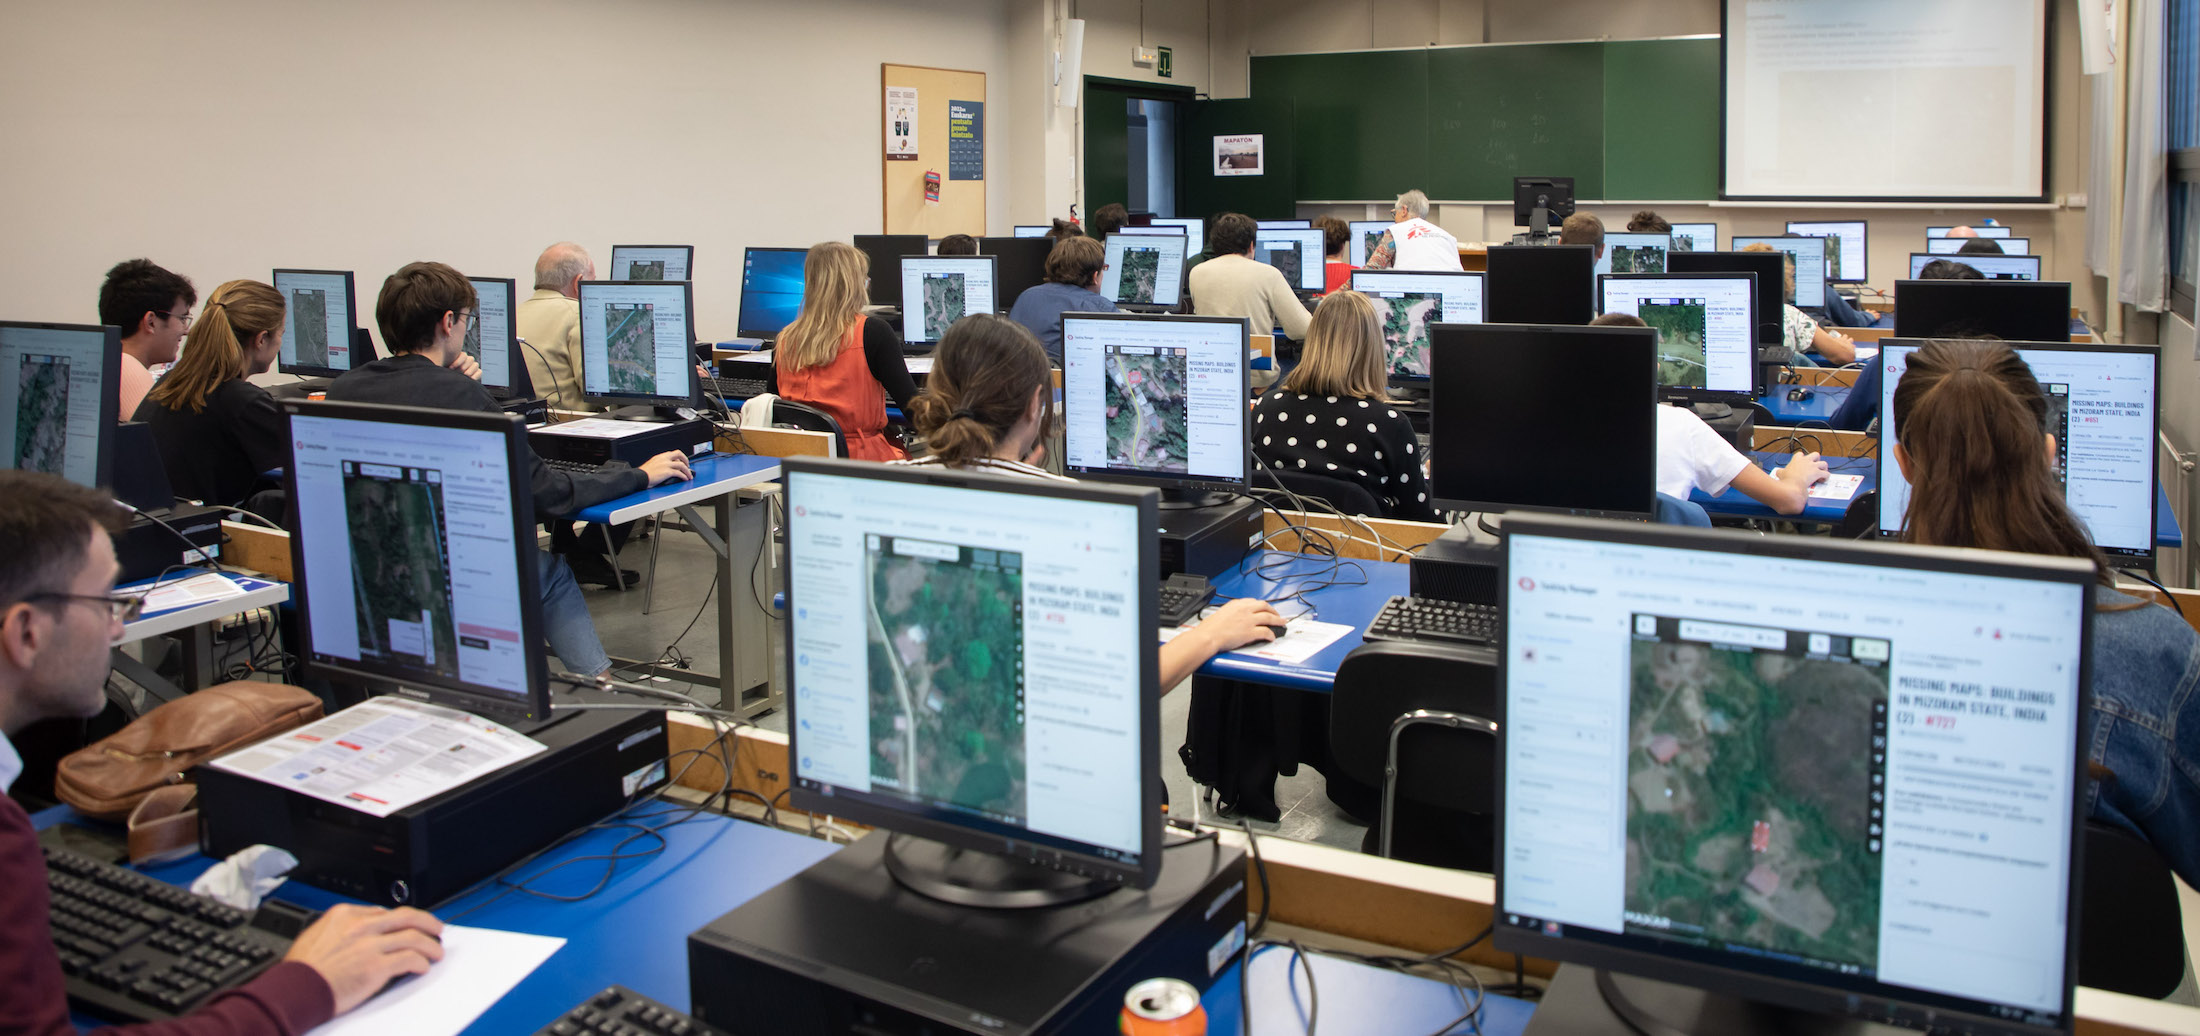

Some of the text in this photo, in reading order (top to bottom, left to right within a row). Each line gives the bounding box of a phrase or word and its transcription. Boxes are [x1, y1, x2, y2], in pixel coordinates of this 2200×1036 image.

[1899, 676, 2056, 705] MISSING MAPS: BUILDINGS
[1896, 711, 1914, 725] (2)
[1898, 694, 2048, 722] IN MIZORAM STATE, INDIA
